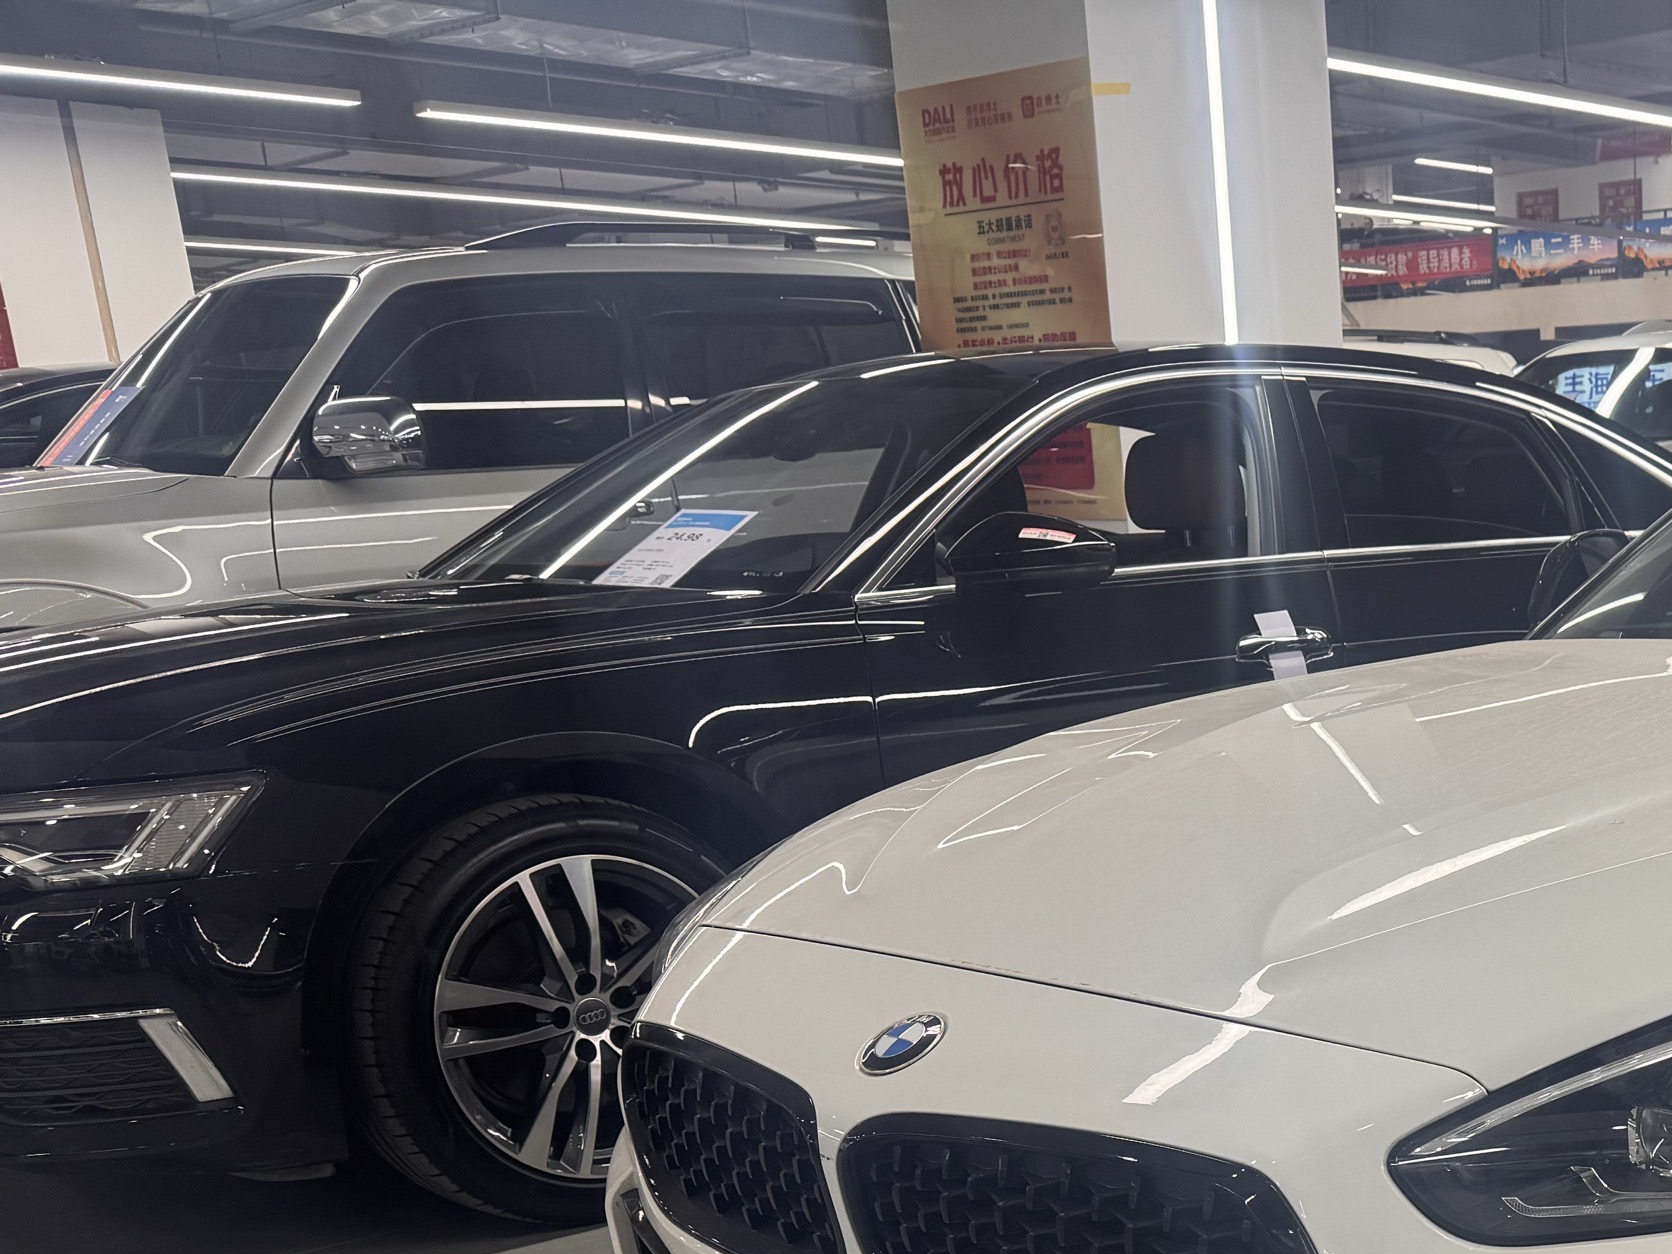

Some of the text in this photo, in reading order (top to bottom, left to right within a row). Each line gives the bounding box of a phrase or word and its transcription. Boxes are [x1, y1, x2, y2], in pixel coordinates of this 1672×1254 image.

[921, 103, 955, 128] DALI
[938, 146, 1065, 209] 放心价格
[976, 213, 1034, 236] 五大郑重承诺
[987, 234, 1025, 246] COMMITMENT
[1512, 234, 1603, 259] 小鹏二手车
